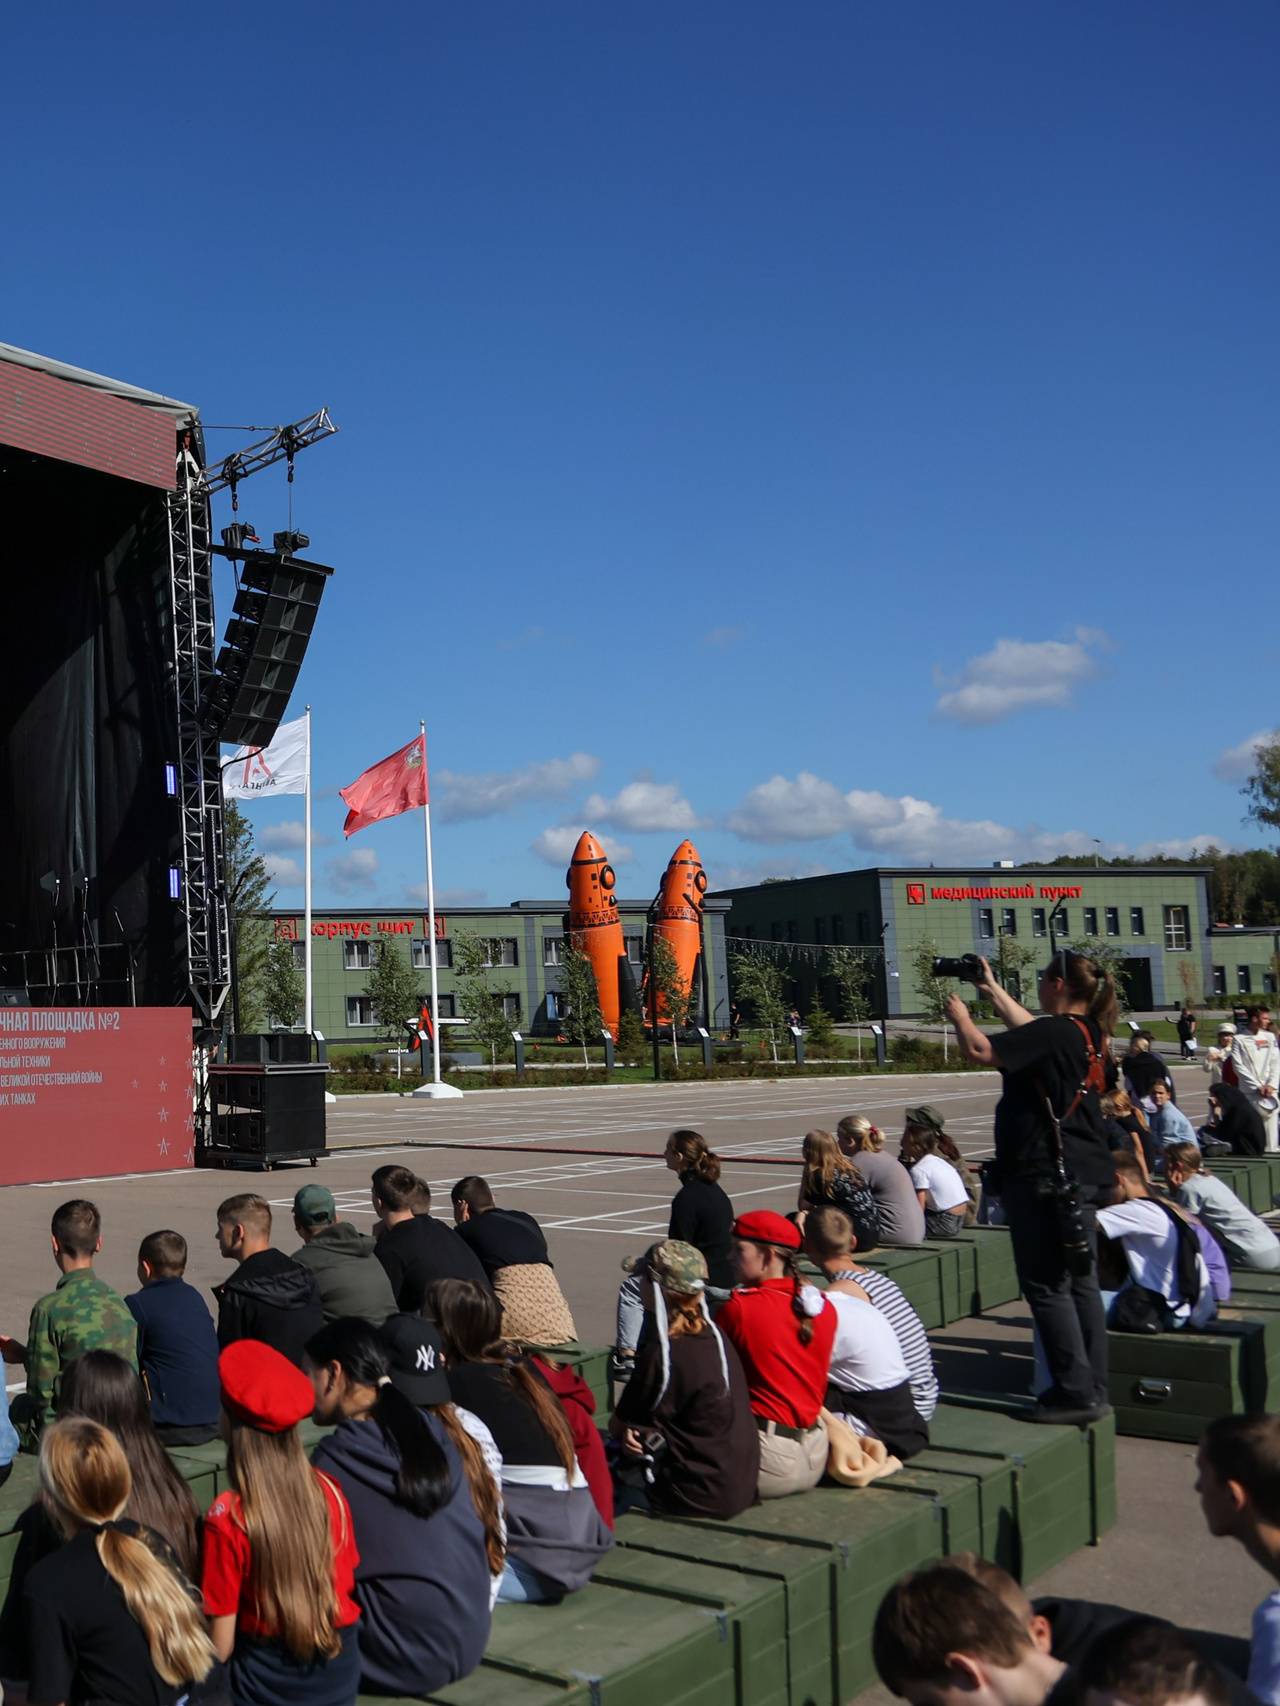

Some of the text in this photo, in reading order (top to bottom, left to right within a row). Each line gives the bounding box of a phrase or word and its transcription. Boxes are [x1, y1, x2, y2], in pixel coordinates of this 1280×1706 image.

[931, 883, 1082, 902] медицинский пункт
[32, 1011, 95, 1033] ПЛОЩАДКА
[98, 1011, 119, 1030] №2
[24, 1037, 65, 1049] ВООРУЖЕНИЯ
[22, 1056, 50, 1067] ТЕХНИКИ
[1, 1073, 30, 1086] ВЕЛИКОЙ
[10, 1093, 35, 1105] ТАНКАХ
[415, 1344, 435, 1371] NY
